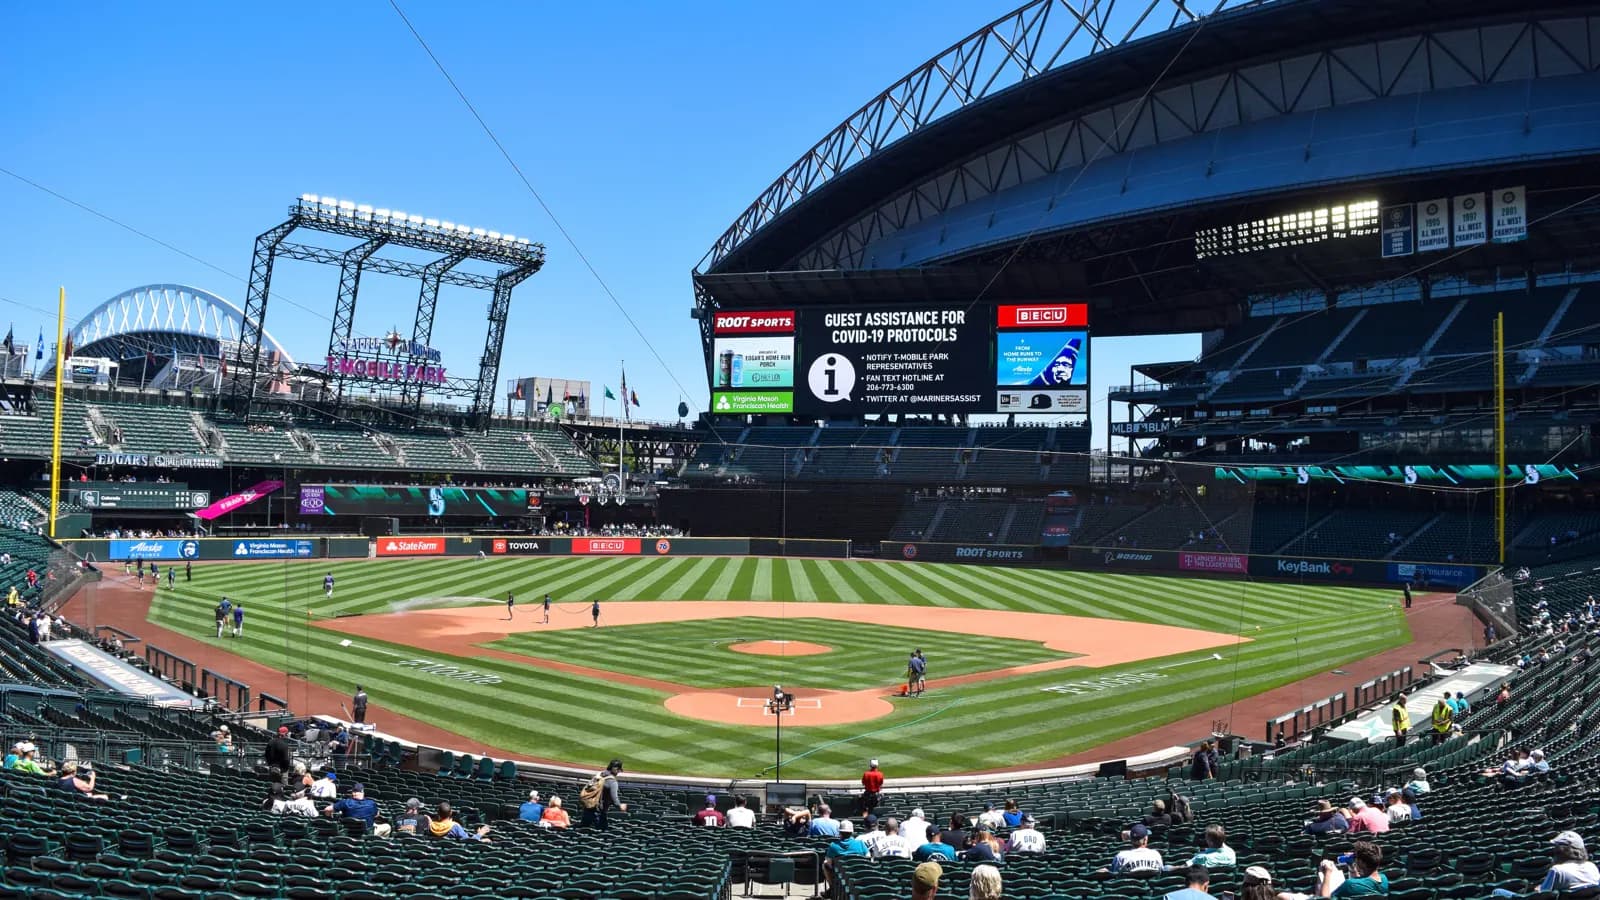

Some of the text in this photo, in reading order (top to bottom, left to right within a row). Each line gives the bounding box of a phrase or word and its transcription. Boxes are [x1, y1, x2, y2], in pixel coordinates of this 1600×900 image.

[1507, 216, 1521, 226] WEST
[1468, 222, 1482, 231] WEST
[1431, 228, 1444, 237] WEST
[1455, 232, 1485, 242] CHAMPIONS
[1494, 227, 1525, 237] CHAMPIONS
[1419, 237, 1448, 247] CHAMPIONS
[825, 310, 965, 327] GUEST ASSISTANCE FOR
[1020, 311, 1063, 321] BECU
[717, 317, 791, 328] ROOT SPORTS
[832, 328, 957, 343] COVID-19 PROTOCOLS
[400, 339, 441, 363] MARINERS
[325, 355, 447, 384] T-MOBILE PARK
[866, 362, 933, 370] REPRESENTATIVES
[866, 374, 881, 382] FAN
[866, 395, 898, 403] TWITTER
[910, 395, 981, 403] @MARINERSASSIST
[1112, 422, 1169, 433] MLB BLM
[130, 542, 162, 552] Alaska
[508, 542, 539, 550] TOYOTA
[956, 547, 1023, 559] ROOT SPORTS
[1117, 553, 1153, 561] BOEING
[1277, 559, 1331, 575] KeyBank
